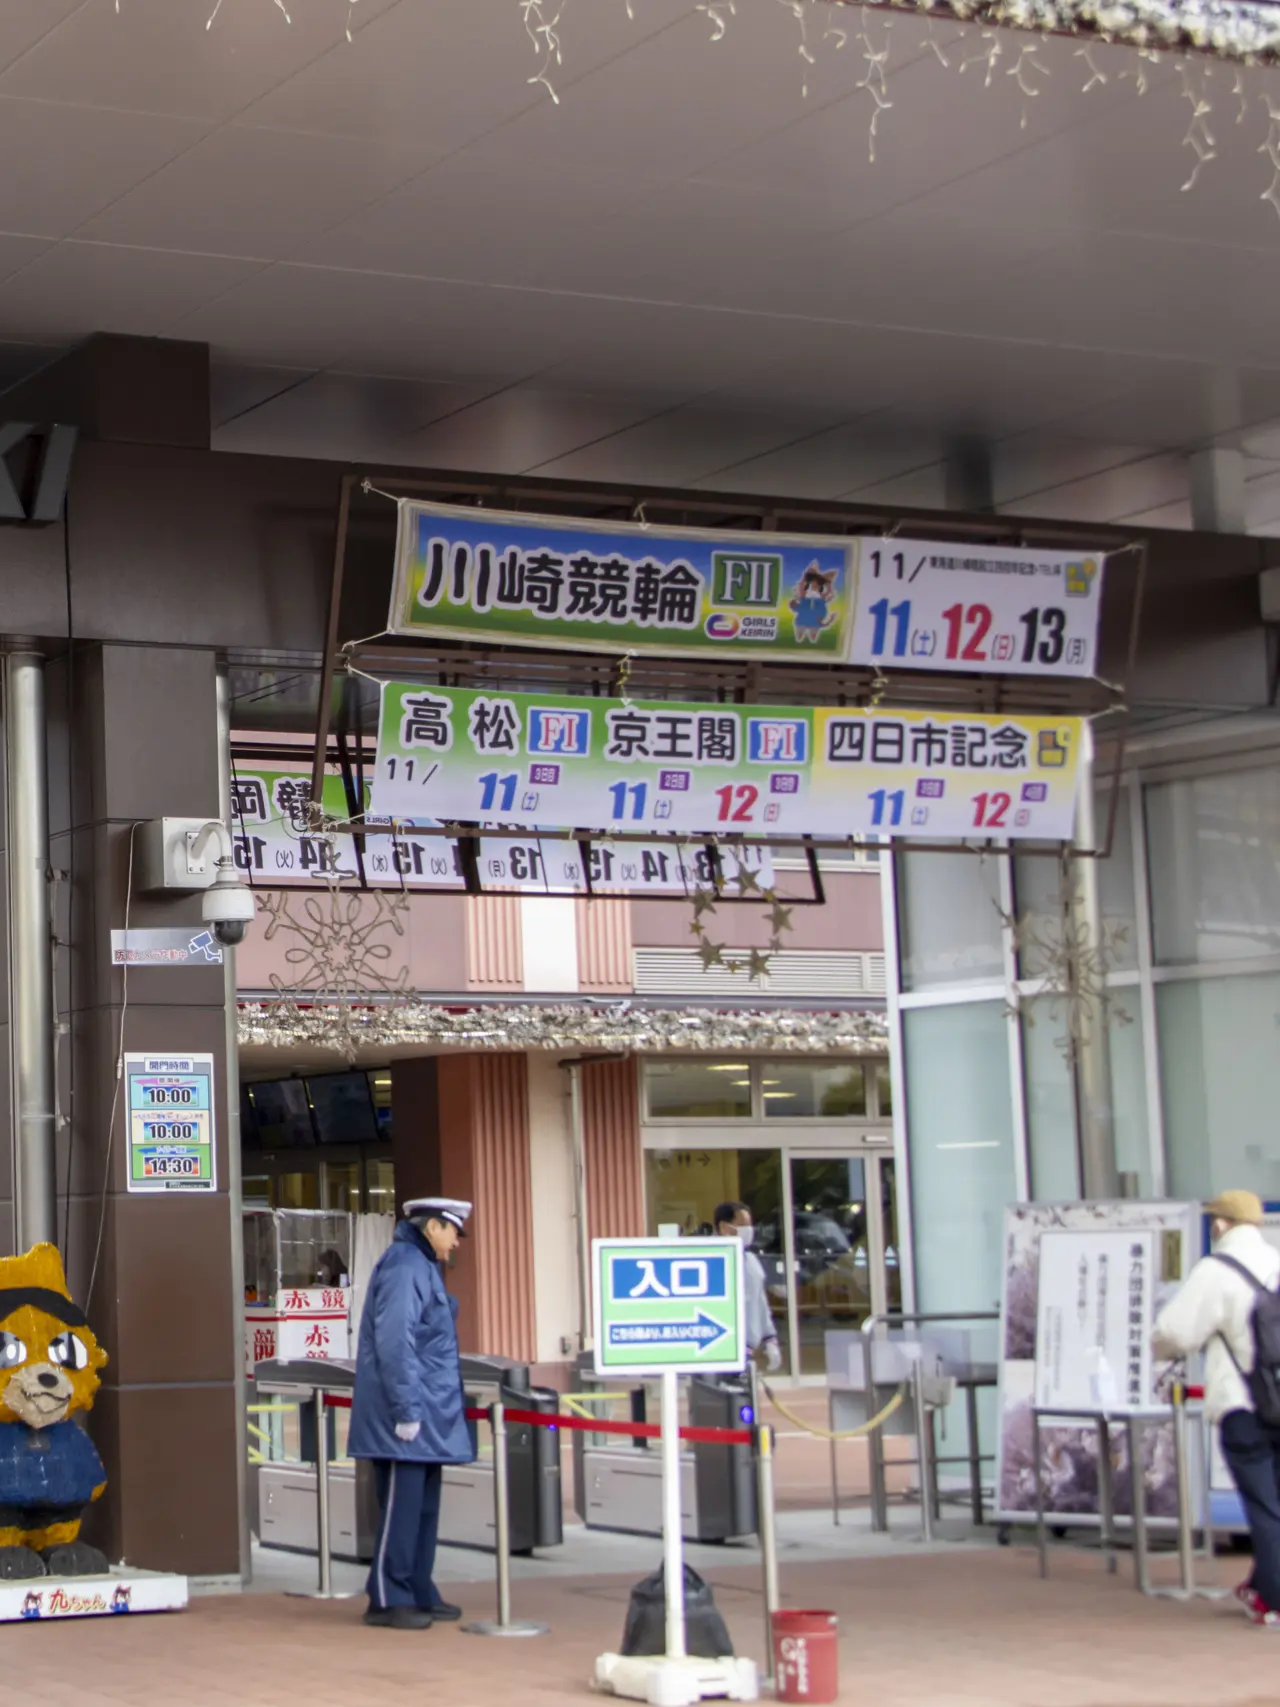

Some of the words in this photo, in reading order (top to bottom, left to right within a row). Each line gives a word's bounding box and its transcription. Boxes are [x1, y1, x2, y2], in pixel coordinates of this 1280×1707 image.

[423, 543, 700, 623] 川崎競輪
[740, 627, 775, 638] KEIRIN
[742, 617, 776, 628] GIRLS
[869, 598, 911, 658] 11
[911, 629, 937, 657] (土)
[942, 603, 992, 661] 12
[991, 634, 1015, 661] (日)
[1019, 607, 1066, 665] 13
[1066, 638, 1087, 665] (月)
[405, 698, 516, 750] 高松
[608, 711, 736, 761] 京王閣
[828, 722, 1027, 768] 四日市記念
[479, 773, 518, 811] 11
[608, 781, 647, 820] 11
[715, 785, 758, 821] 12
[868, 789, 904, 826] 11
[972, 792, 1011, 828] 12
[149, 1088, 191, 1103] 10:00
[150, 1124, 192, 1139] 10:00
[150, 1159, 193, 1174] 14:30
[629, 1260, 708, 1297] 入口
[49, 1588, 107, 1613] 九ちゃん
